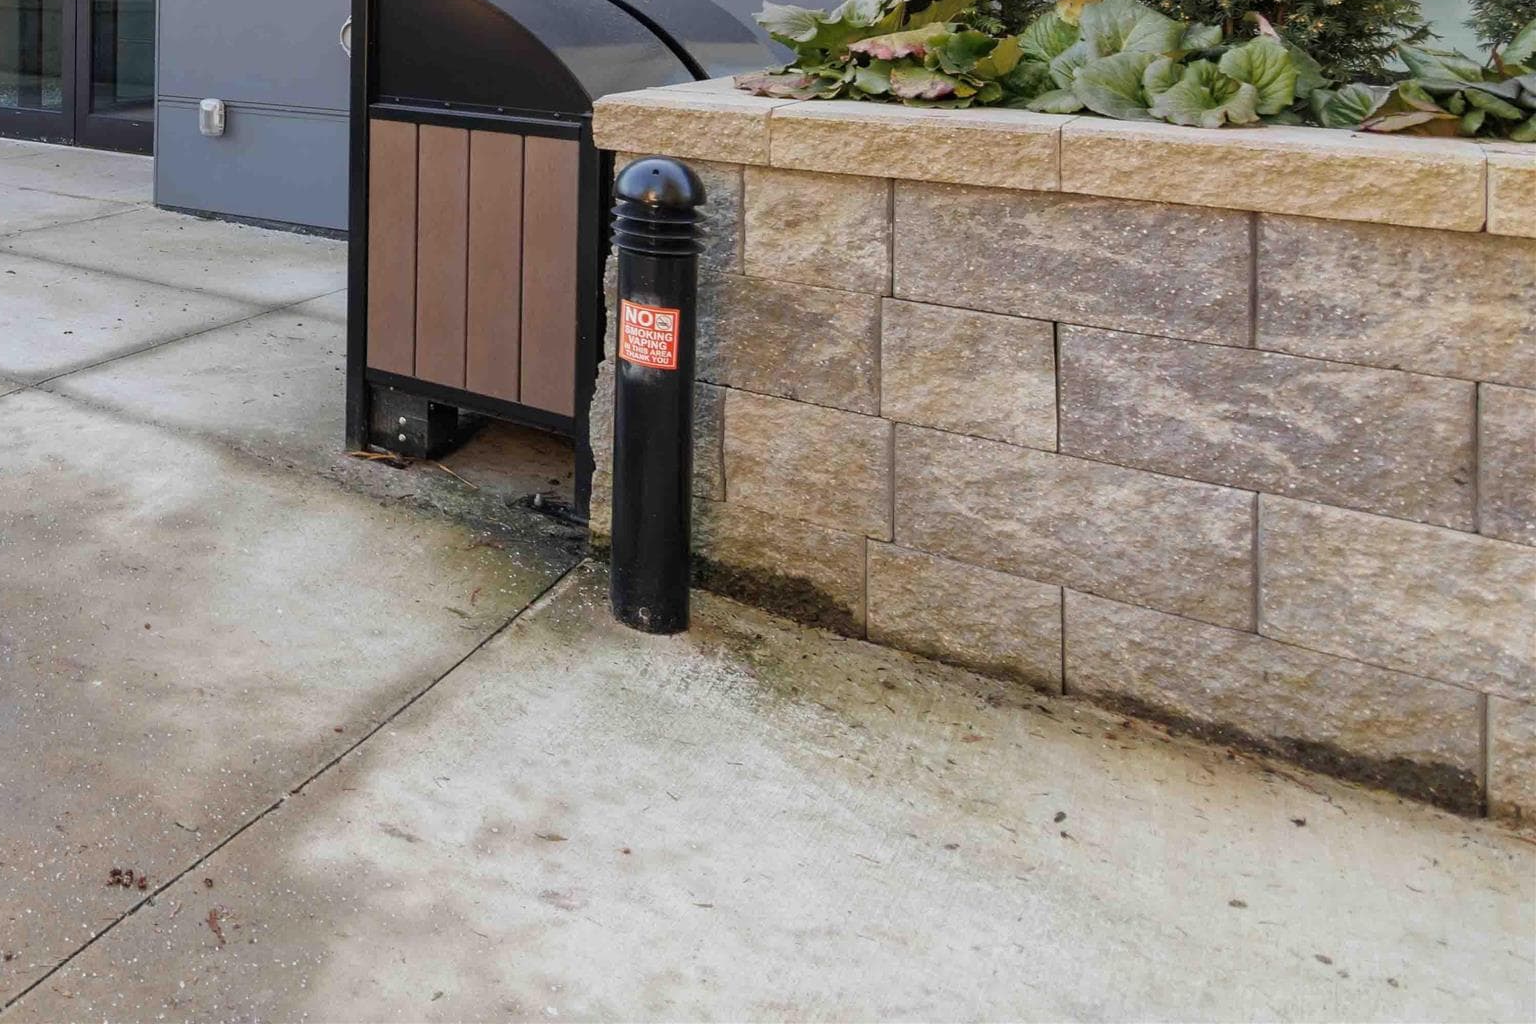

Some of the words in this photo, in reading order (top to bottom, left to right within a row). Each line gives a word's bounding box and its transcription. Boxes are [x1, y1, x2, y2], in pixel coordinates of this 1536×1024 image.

[625, 306, 654, 327] NO
[625, 325, 673, 342] SMOKING
[628, 335, 667, 350] VAPING
[626, 350, 650, 361] THANK
[651, 356, 669, 364] YOU
[650, 349, 672, 358] AREA
